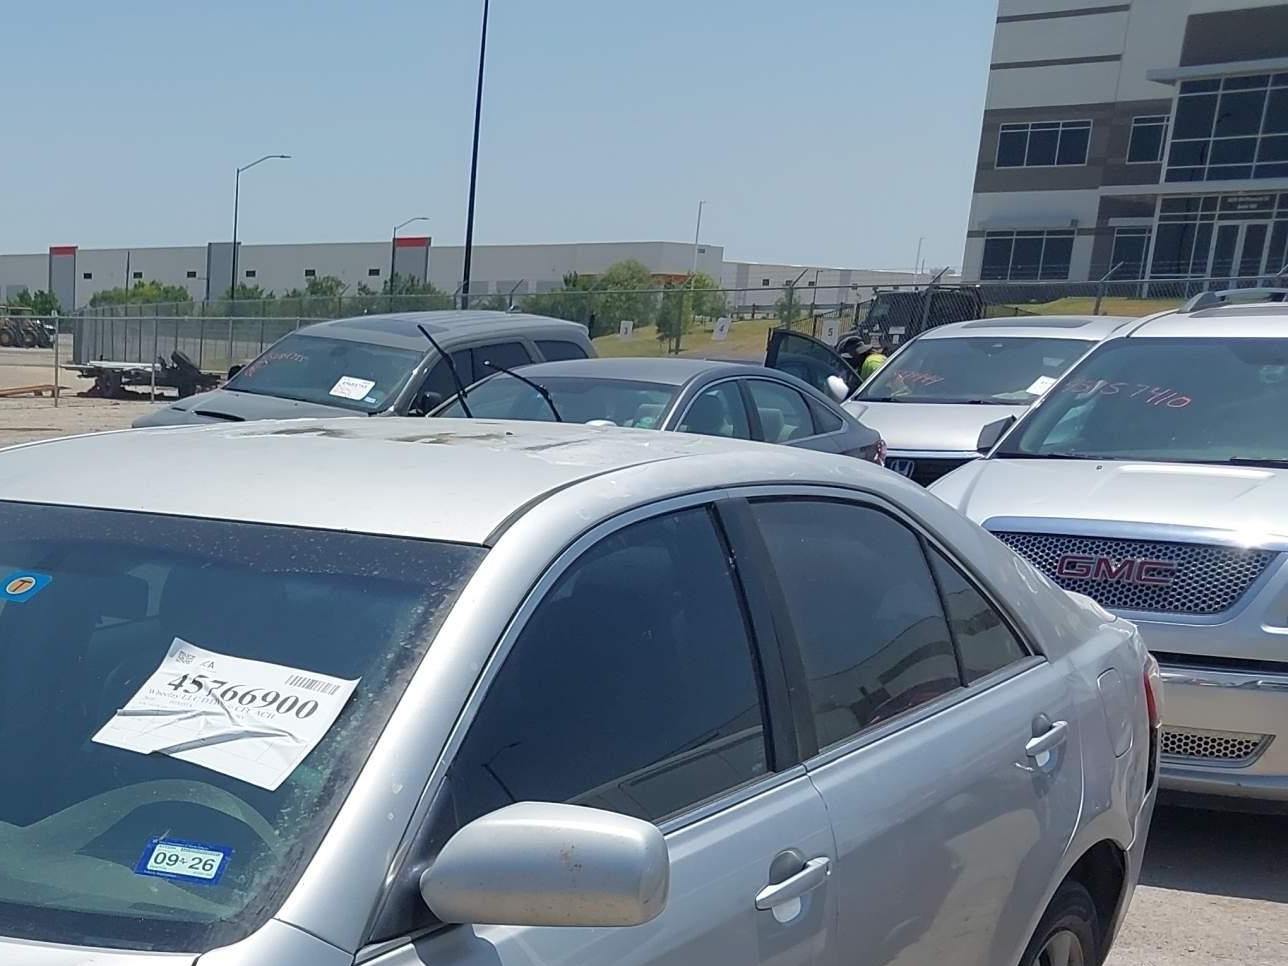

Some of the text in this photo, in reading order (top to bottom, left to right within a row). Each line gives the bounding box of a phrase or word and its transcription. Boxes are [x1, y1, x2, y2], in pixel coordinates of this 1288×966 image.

[1056, 553, 1177, 587] GMC
[168, 673, 319, 720] 45766900
[153, 851, 179, 867] 09
[187, 856, 216, 872] 26
